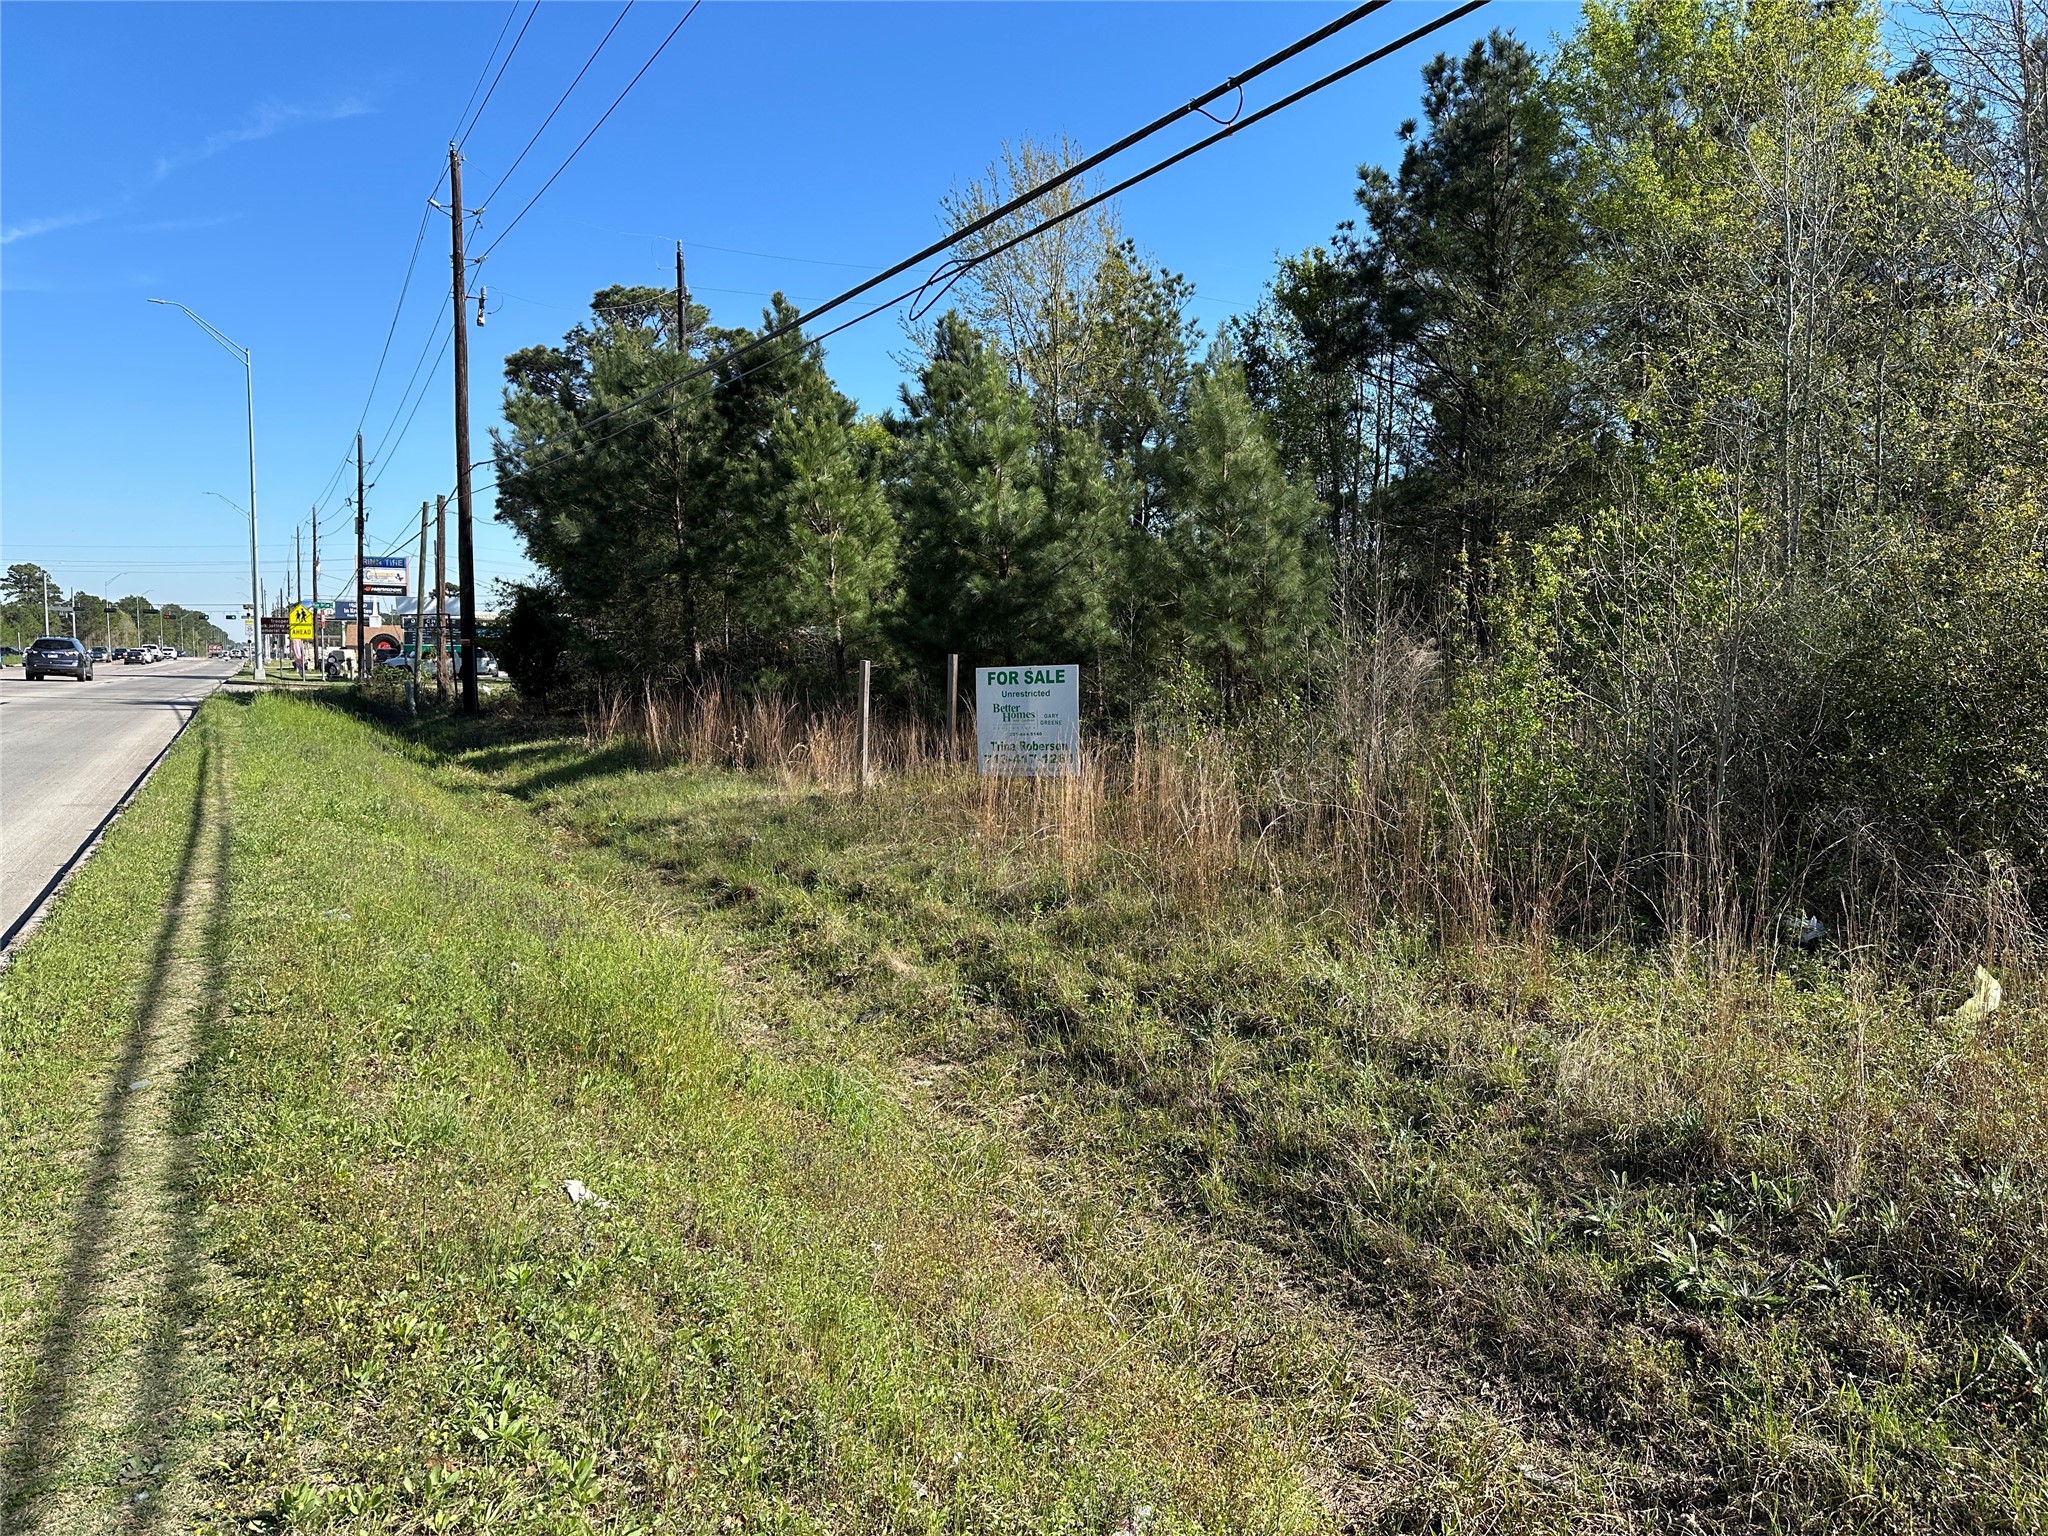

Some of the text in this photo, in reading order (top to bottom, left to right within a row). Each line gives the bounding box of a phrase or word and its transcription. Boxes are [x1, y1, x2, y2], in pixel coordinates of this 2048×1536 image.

[987, 669, 1065, 685] FOR SALE
[1001, 689, 1051, 698] Unrestricted
[993, 703, 1020, 713] Better
[1002, 712, 1035, 722] Homes
[990, 741, 1068, 751] Trina Roberson
